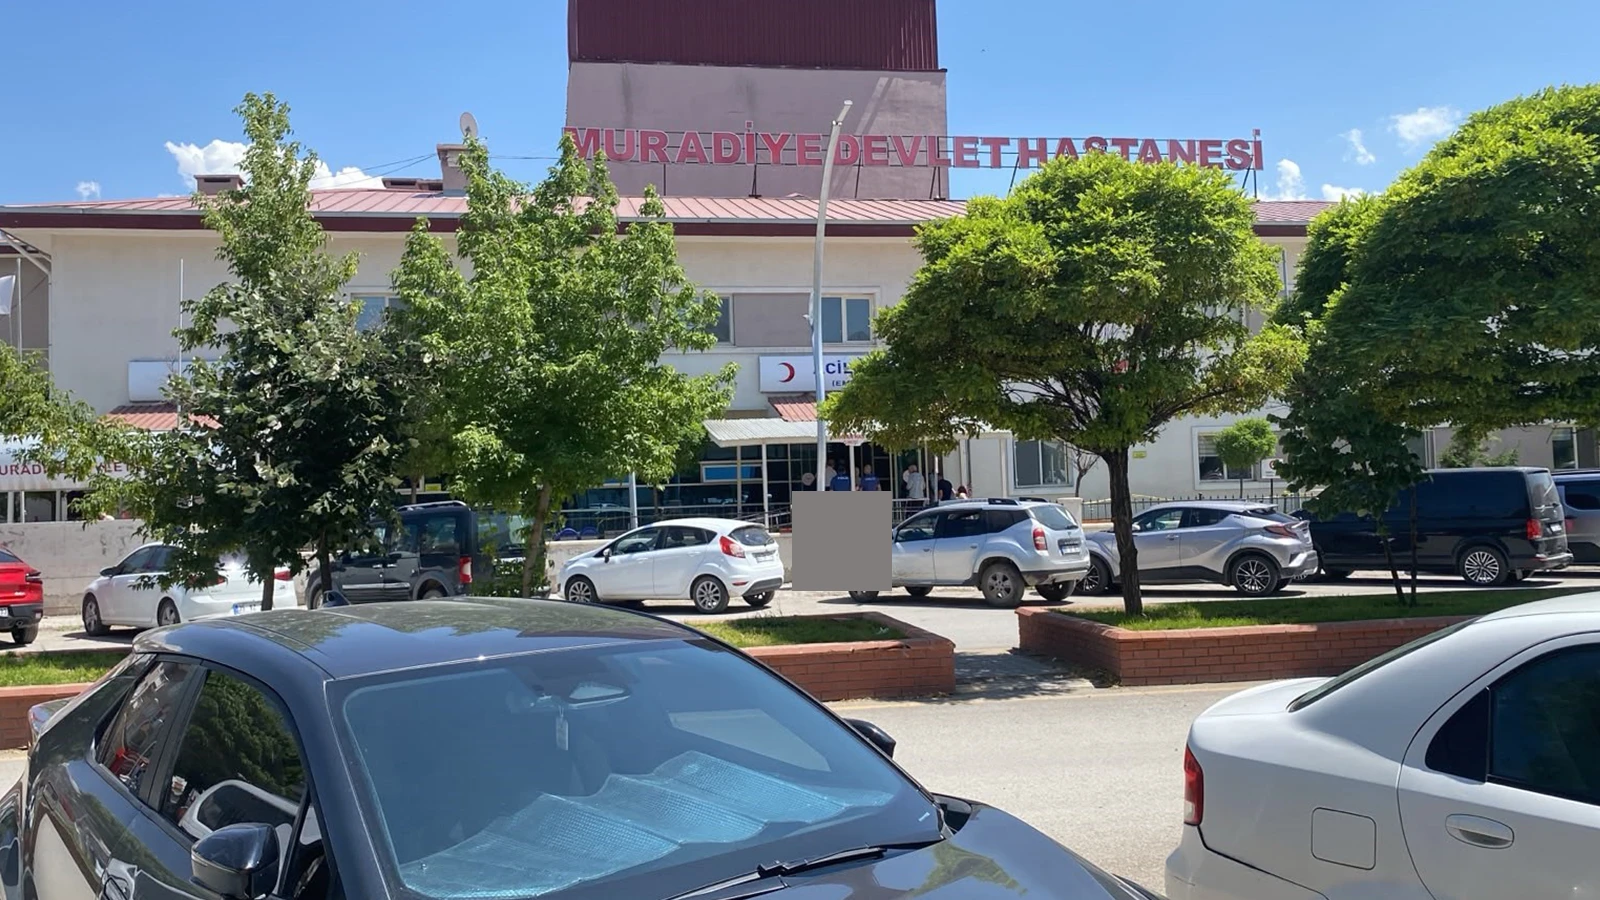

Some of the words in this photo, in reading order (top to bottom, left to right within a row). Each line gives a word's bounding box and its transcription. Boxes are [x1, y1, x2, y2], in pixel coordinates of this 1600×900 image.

[563, 121, 823, 166] MURADİYE
[833, 134, 1010, 168] DEVLET
[1018, 129, 1263, 170] HASTANESİ
[813, 360, 853, 375] CİL
